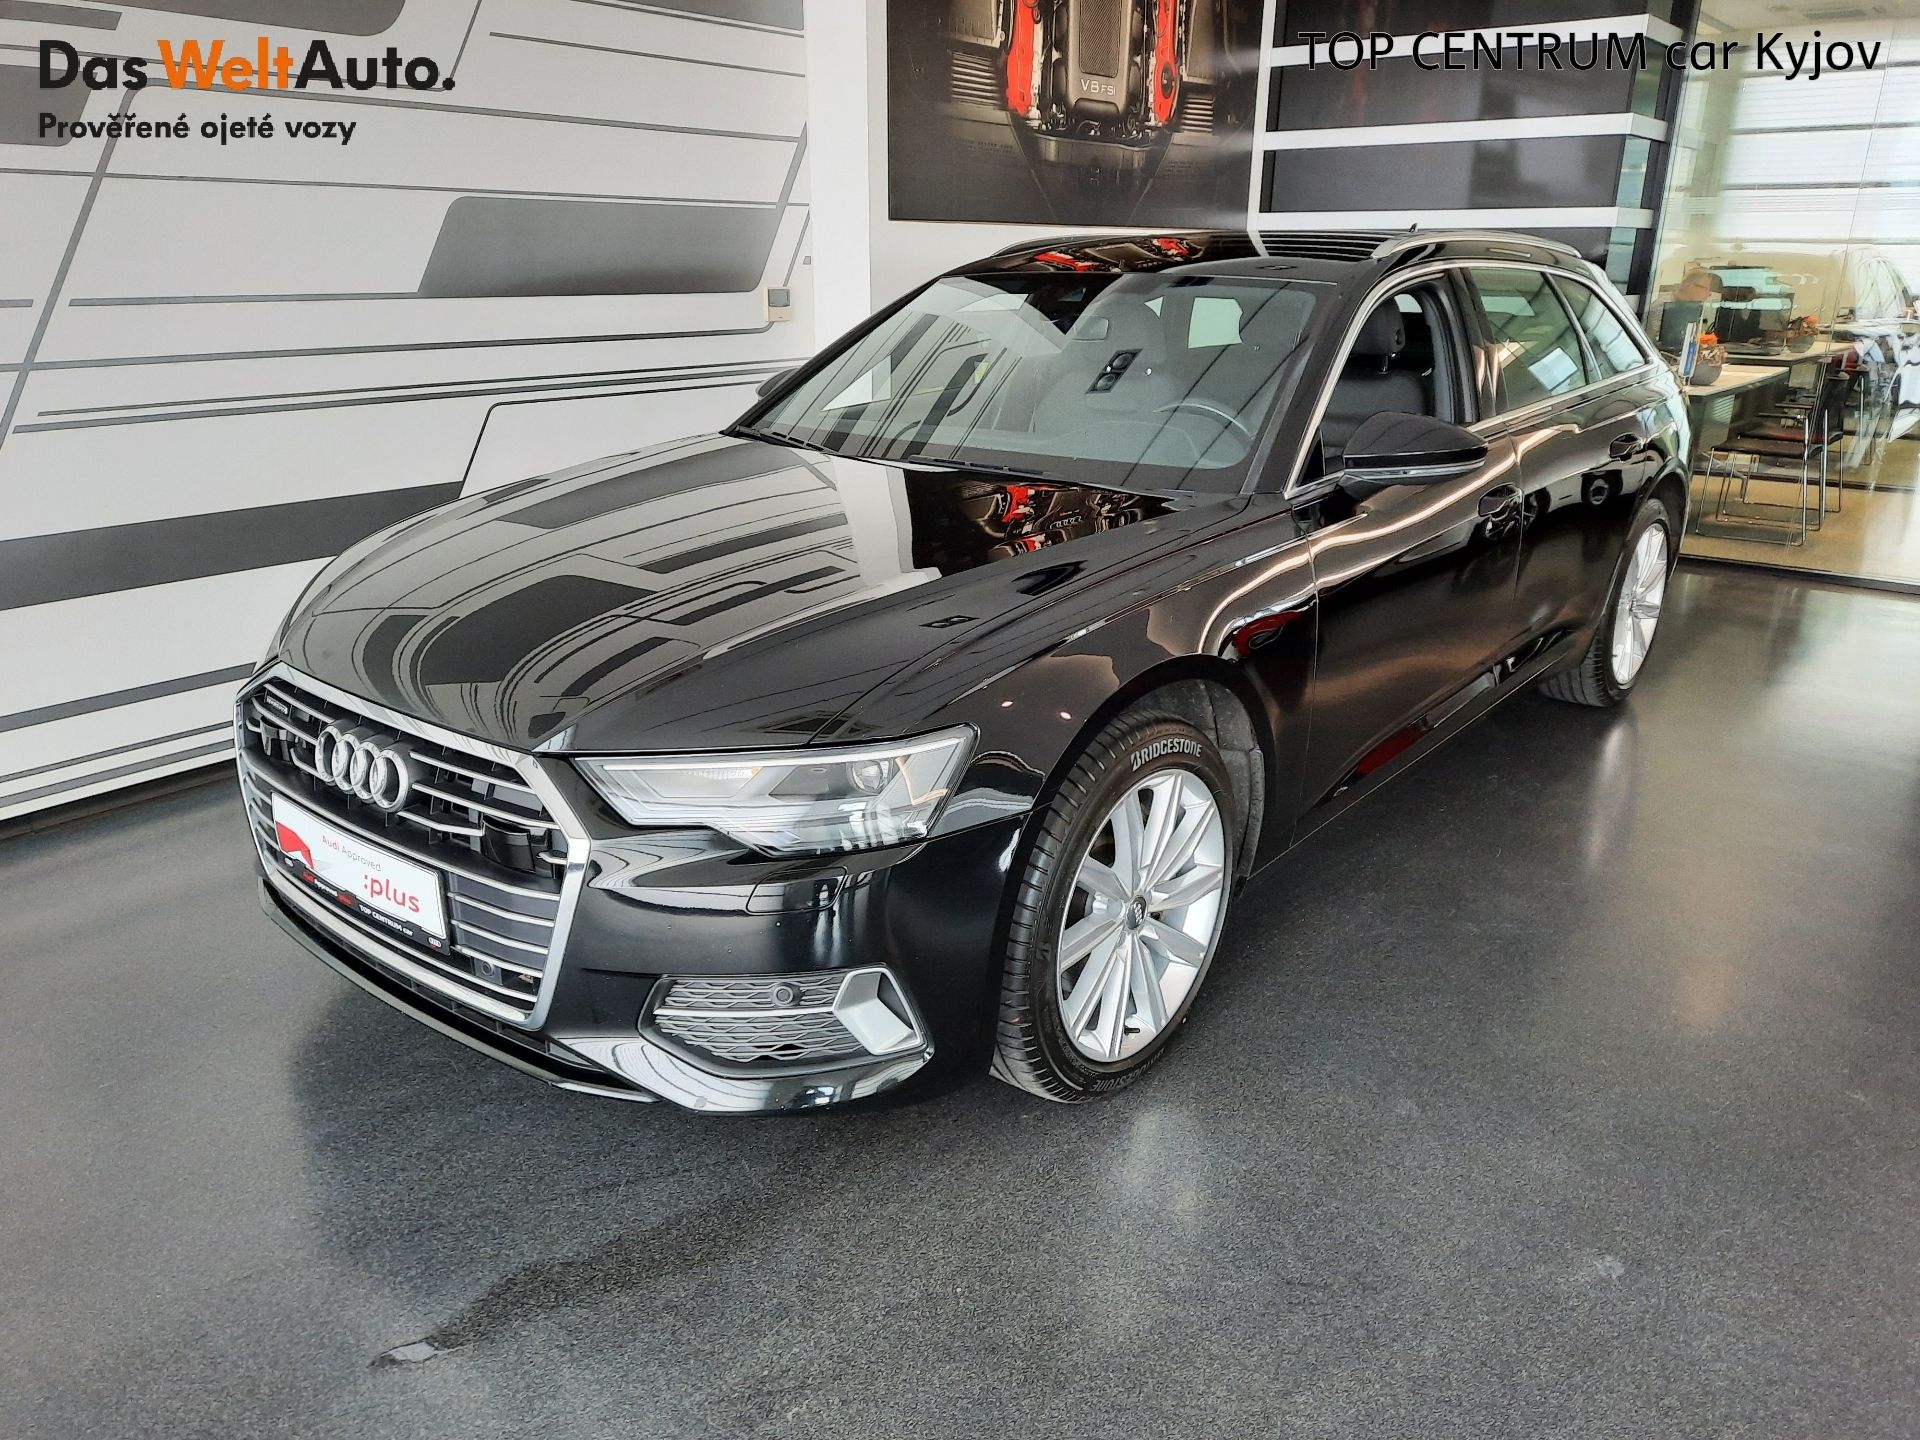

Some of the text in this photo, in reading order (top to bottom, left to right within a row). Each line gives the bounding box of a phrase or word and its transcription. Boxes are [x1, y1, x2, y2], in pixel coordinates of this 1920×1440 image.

[1081, 78, 1116, 96] V8 FSI
[1130, 738, 1203, 772] BRIDGESTONE
[322, 835, 382, 872] Audi Approved
